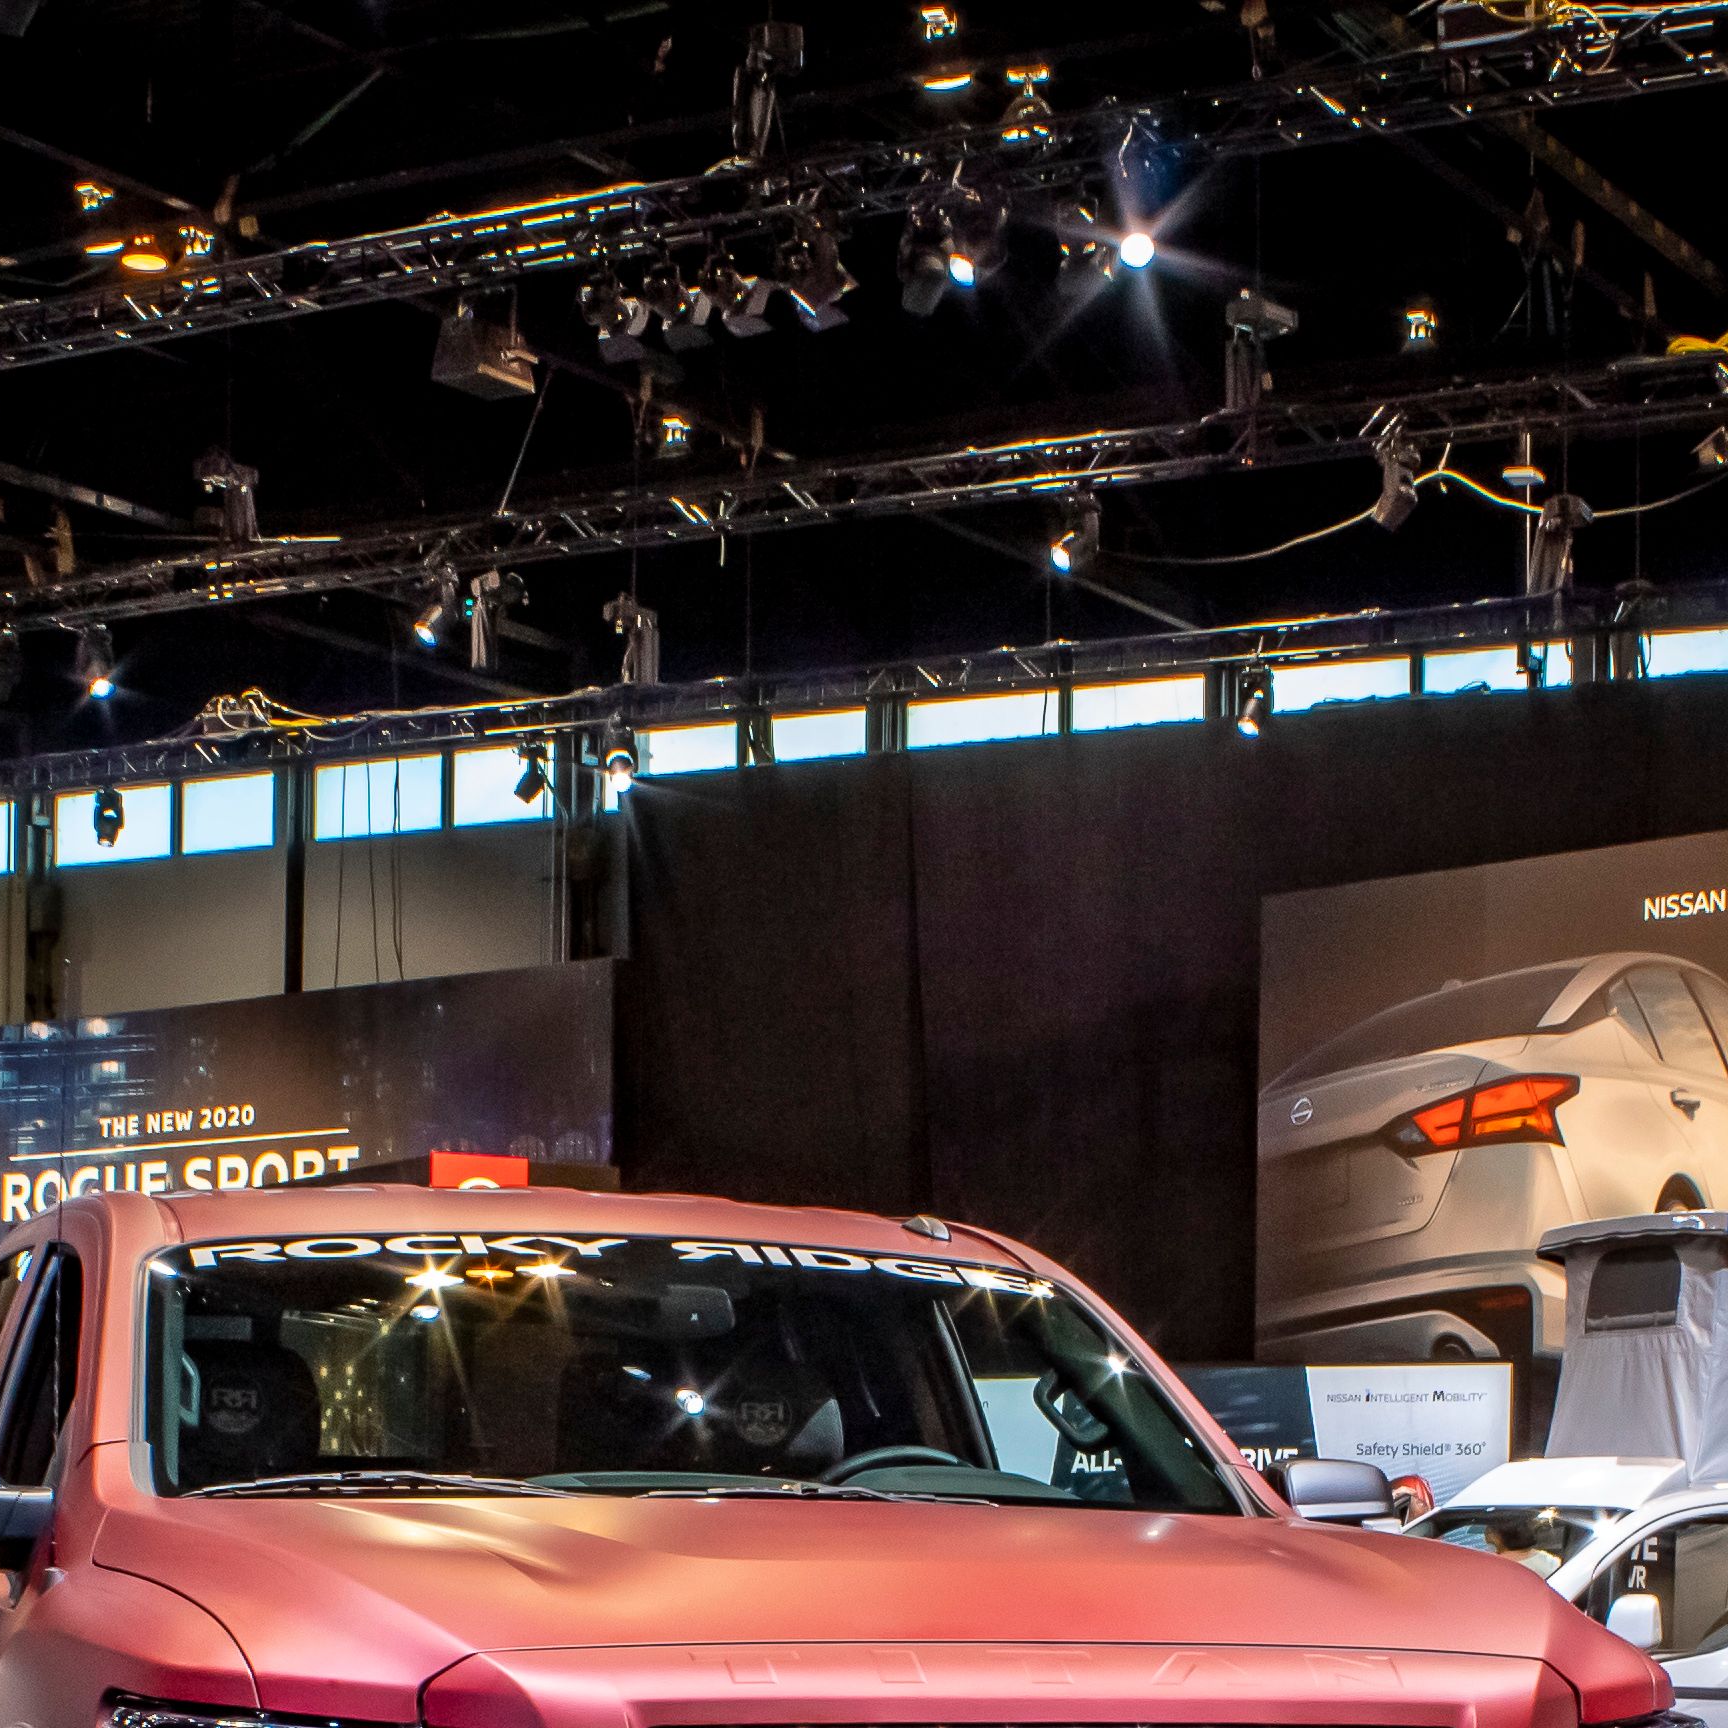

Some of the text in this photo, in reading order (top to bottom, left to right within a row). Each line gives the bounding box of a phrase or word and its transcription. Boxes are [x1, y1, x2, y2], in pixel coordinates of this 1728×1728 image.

[1643, 888, 1727, 921] NISSAN
[99, 1103, 256, 1138] THE NEW 2020
[189, 1234, 630, 1269] ROCKY
[1356, 1442, 1399, 1459] Safety
